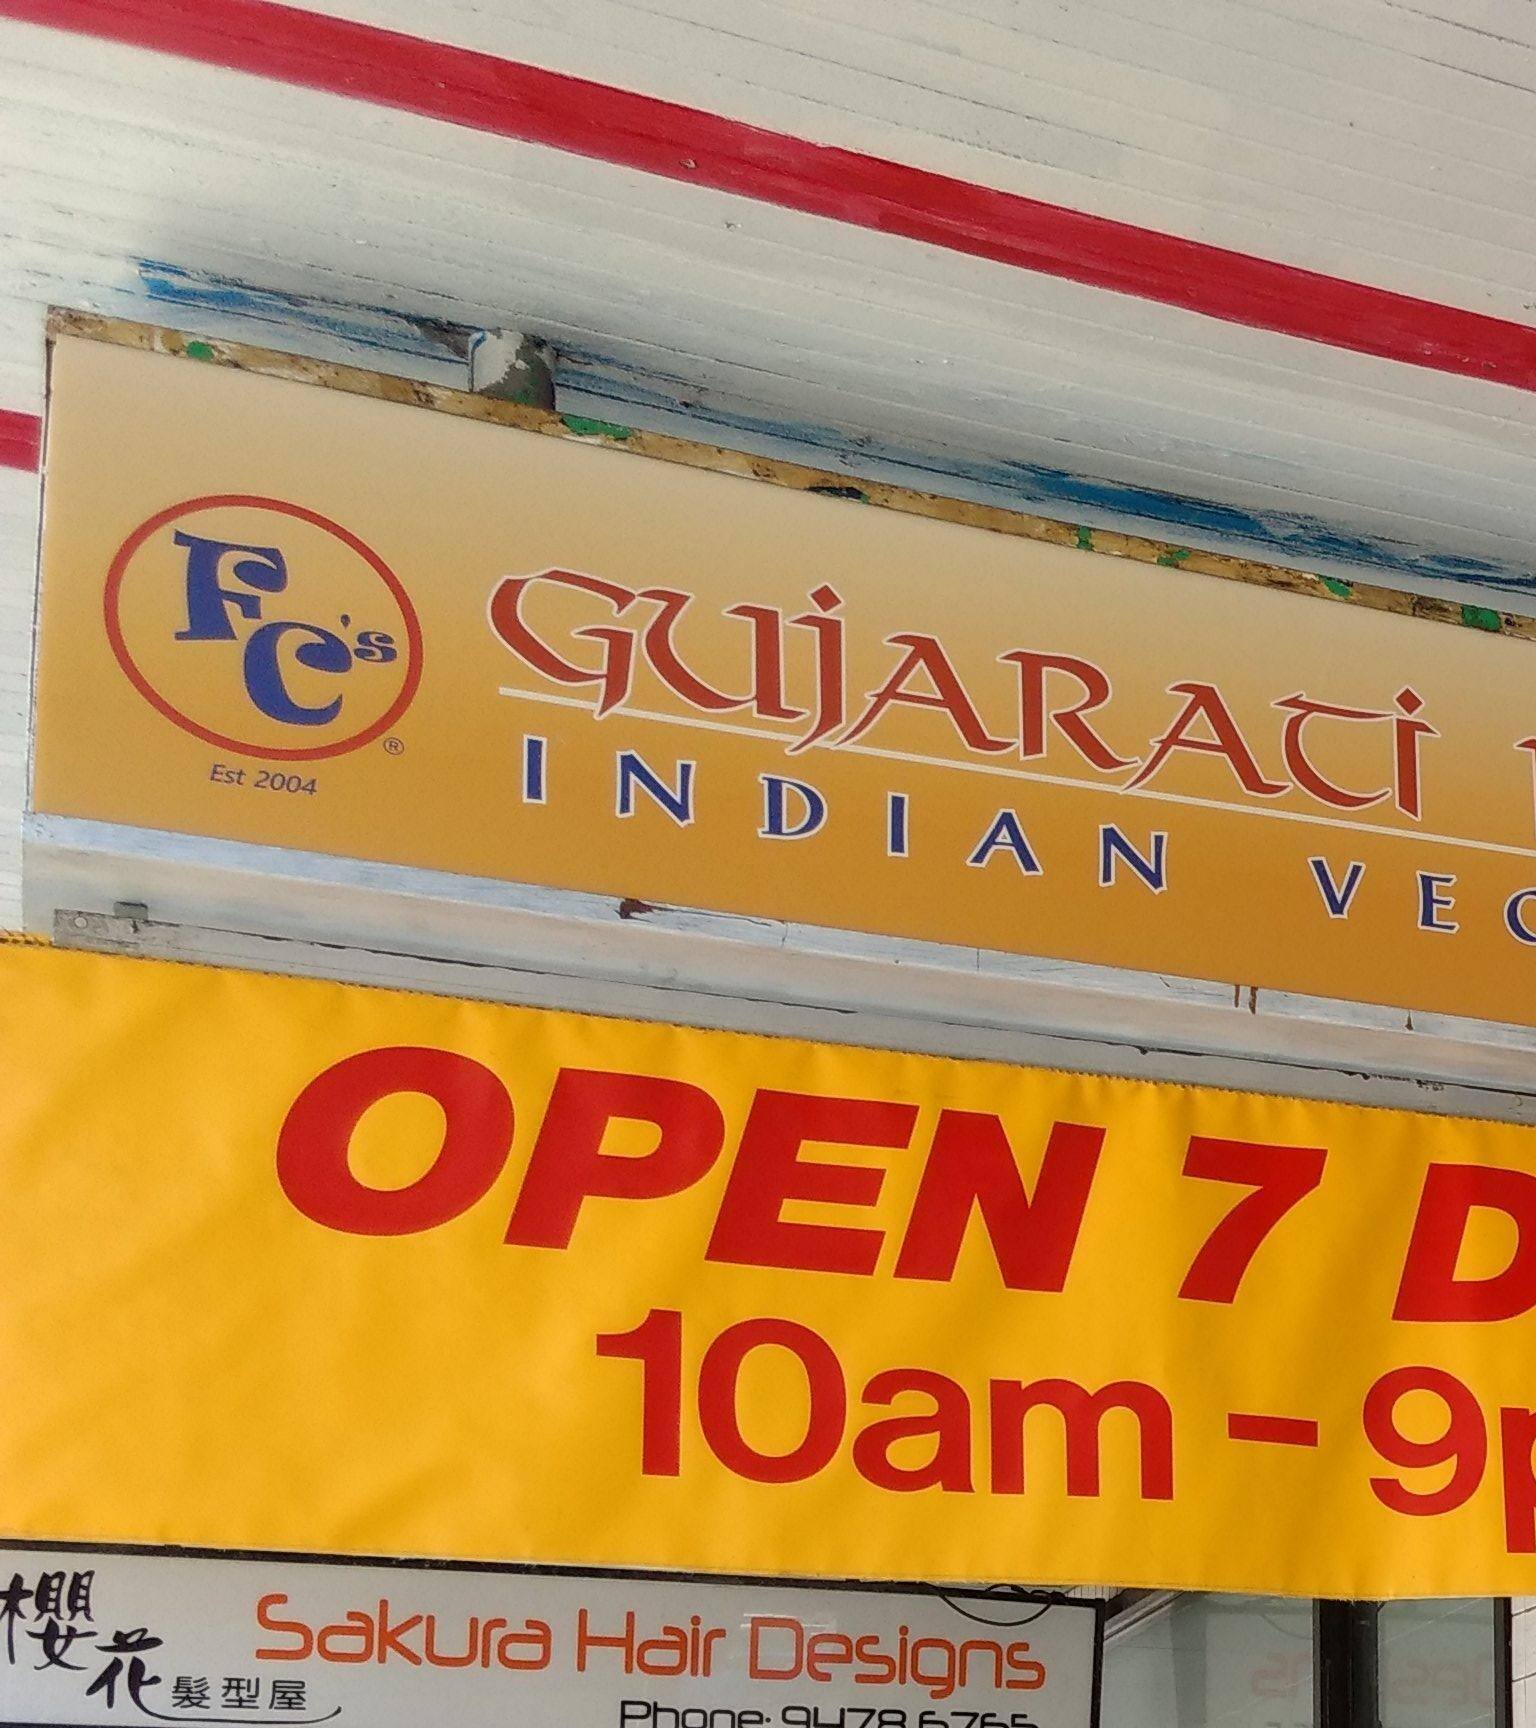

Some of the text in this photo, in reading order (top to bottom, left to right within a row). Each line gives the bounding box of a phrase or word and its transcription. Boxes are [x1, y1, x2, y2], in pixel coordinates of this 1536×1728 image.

[209, 762, 318, 797] Est 2004
[521, 734, 1169, 894] INDIAN
[275, 1045, 1107, 1293] OPEN
[1177, 1135, 1327, 1304] 7
[596, 1308, 1175, 1501] 10am
[255, 1593, 1046, 1699] Sakura Hair Designs
